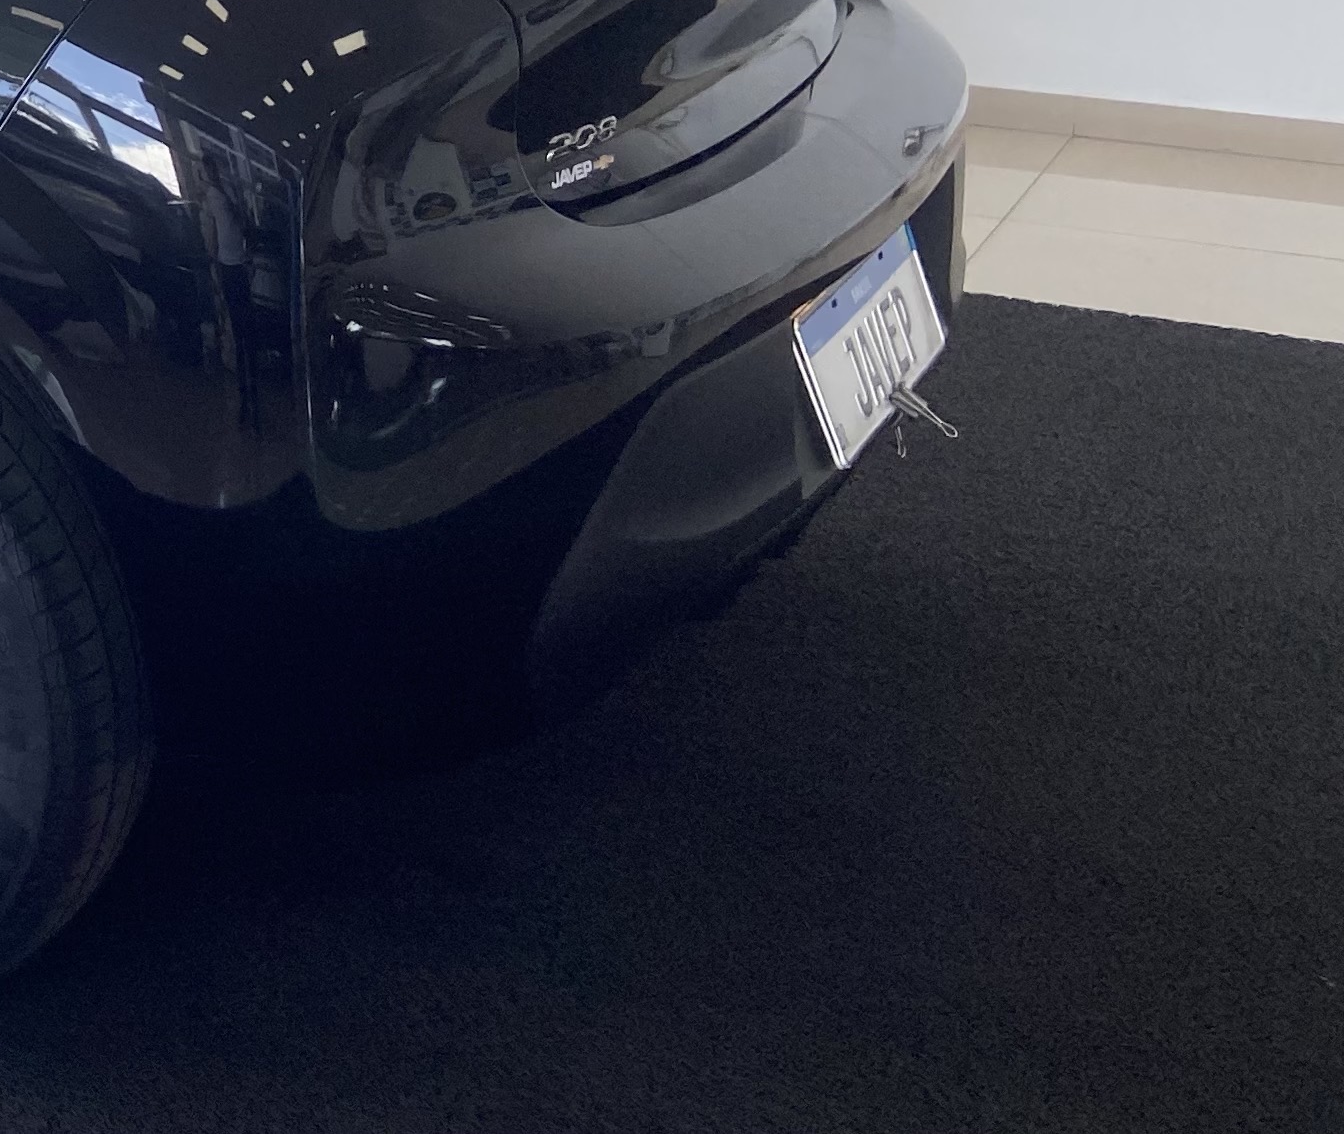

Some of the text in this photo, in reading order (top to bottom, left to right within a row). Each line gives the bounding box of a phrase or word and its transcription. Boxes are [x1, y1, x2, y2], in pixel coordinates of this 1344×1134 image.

[546, 115, 618, 162] 208
[551, 159, 593, 189] JAVEP
[842, 285, 918, 417] JAVEP
